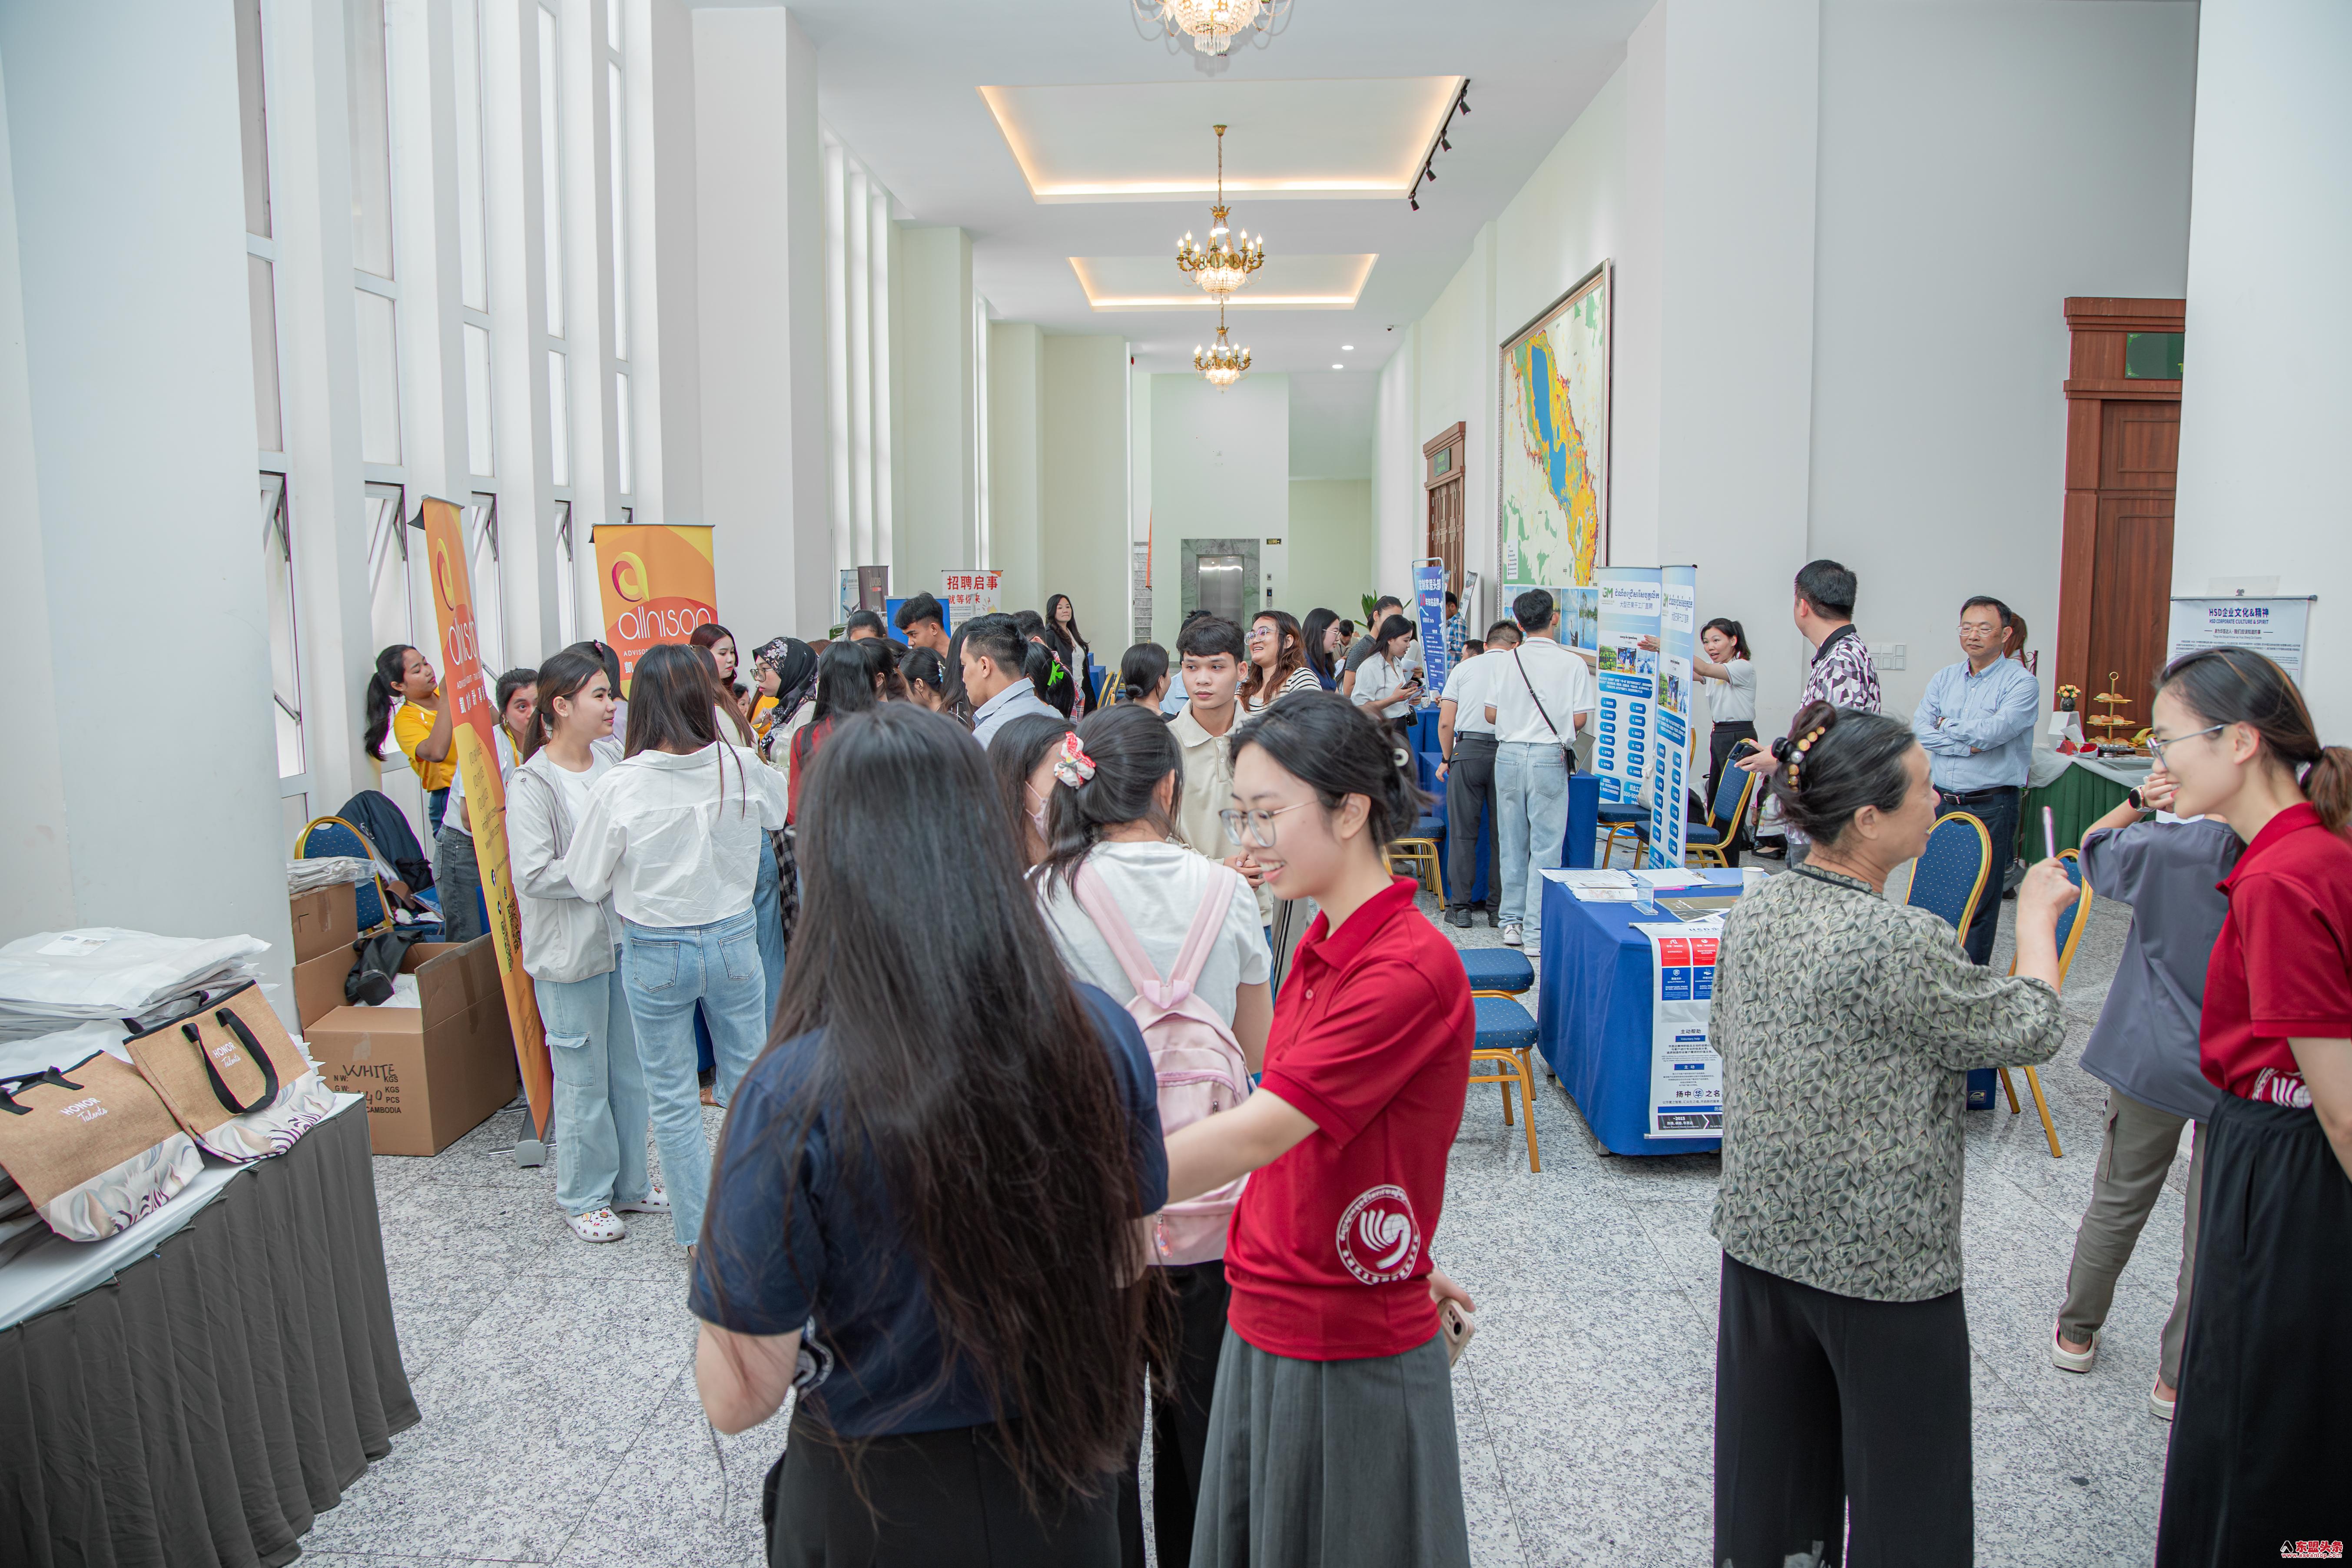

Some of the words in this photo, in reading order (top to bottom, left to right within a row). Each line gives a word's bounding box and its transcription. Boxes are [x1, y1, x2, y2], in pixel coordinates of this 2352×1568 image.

[947, 576, 998, 590] 招聘启事
[2209, 607, 2269, 618] HSD企业文化&精神
[212, 1042, 237, 1059] HONOR
[221, 1053, 241, 1068] Talents
[343, 1064, 397, 1078] WHITE
[1676, 1090, 1720, 1098] 扬中华之名
[60, 1097, 101, 1116] HONOR
[77, 1106, 108, 1123] Talents
